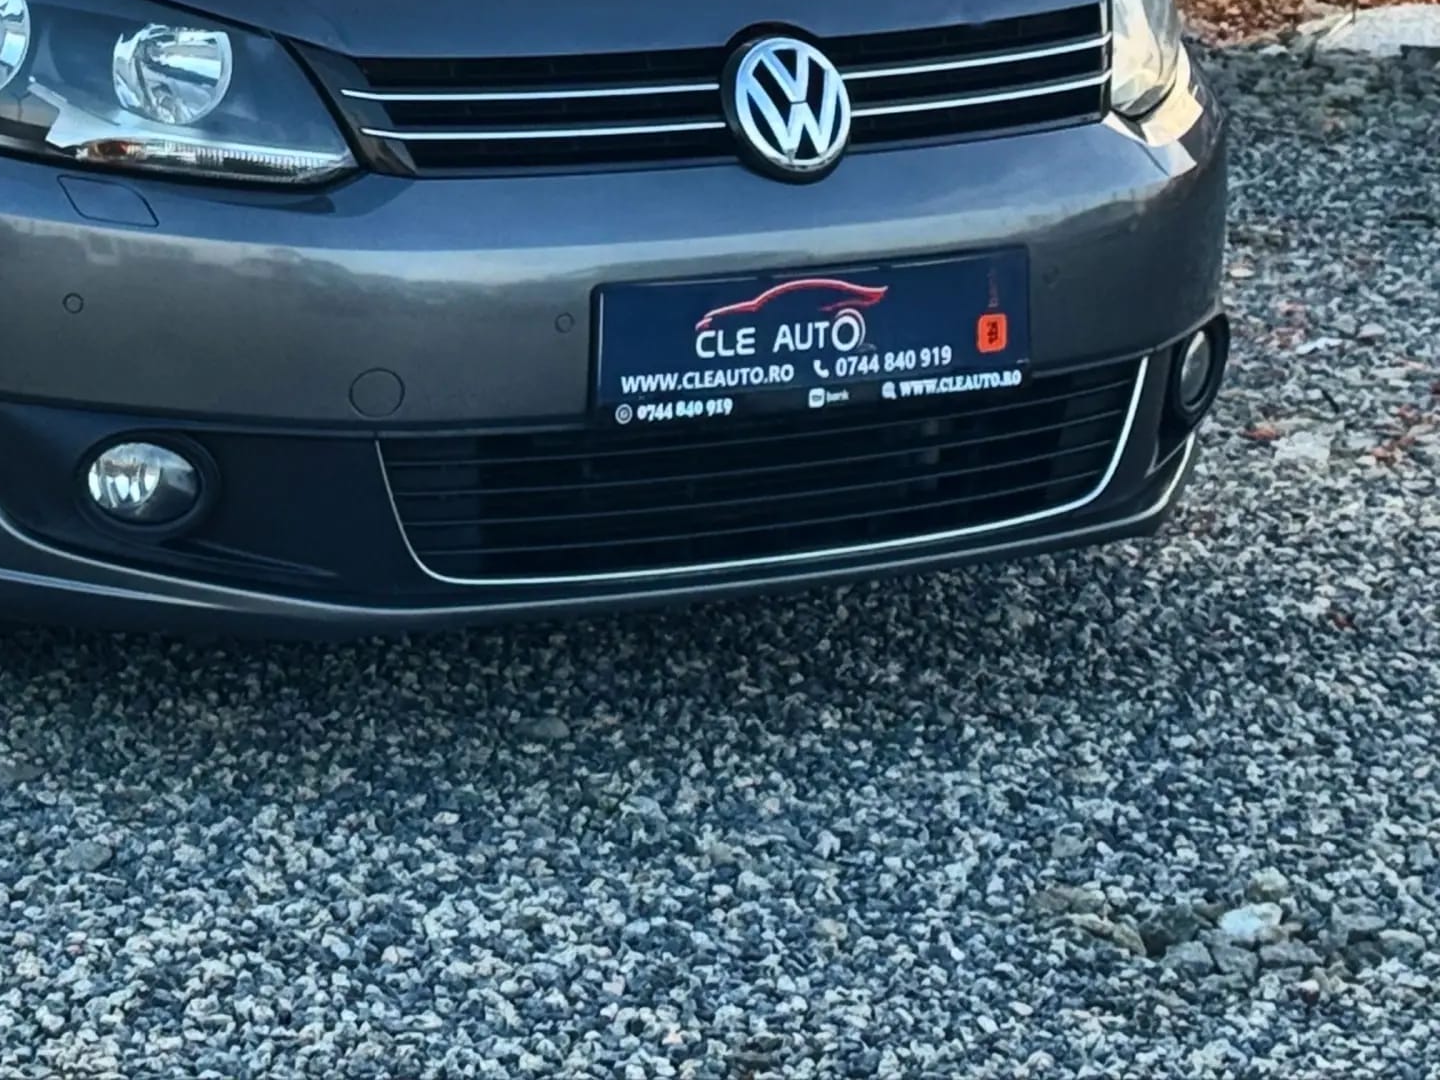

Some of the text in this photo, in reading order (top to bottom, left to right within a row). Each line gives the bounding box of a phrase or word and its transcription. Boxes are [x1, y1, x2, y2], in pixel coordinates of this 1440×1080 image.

[696, 315, 861, 358] CLE AUTO
[835, 345, 952, 377] 0744 840 919
[621, 364, 794, 394] WWW.CLEAUTO.RO
[637, 398, 733, 421] 0744 840 919
